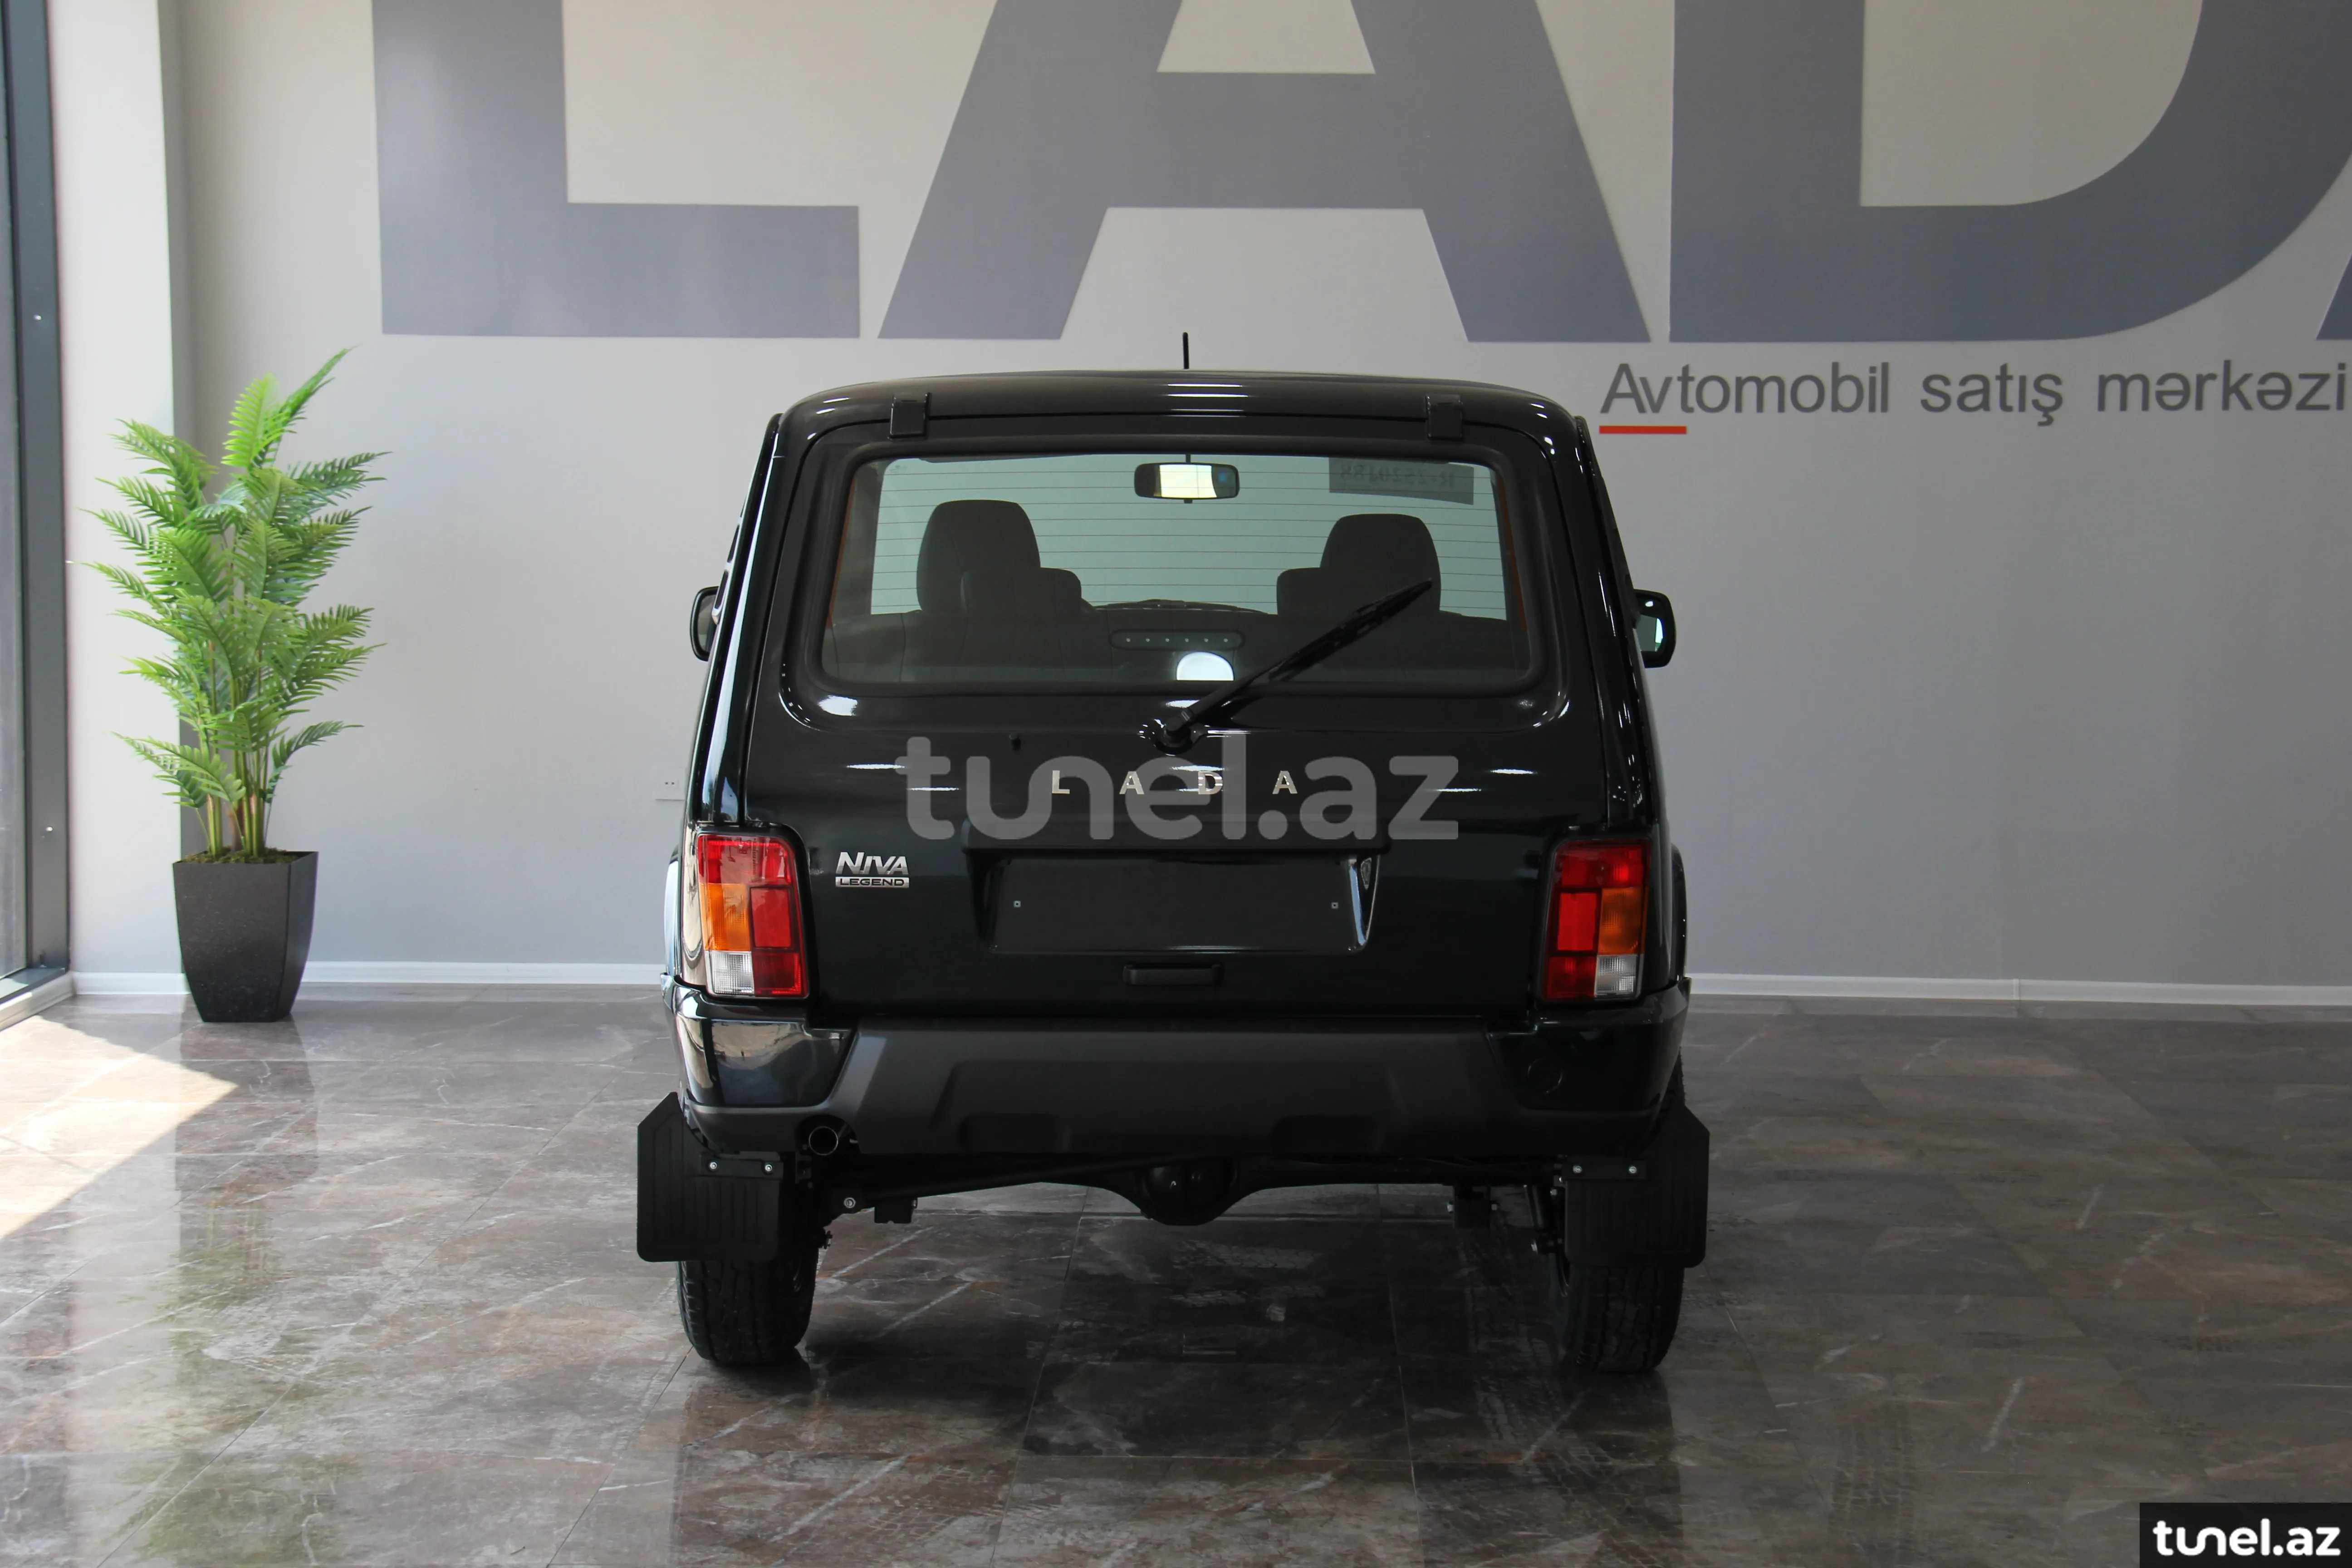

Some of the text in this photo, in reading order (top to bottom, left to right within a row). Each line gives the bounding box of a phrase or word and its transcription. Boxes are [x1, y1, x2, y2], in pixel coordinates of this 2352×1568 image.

[372, 0, 2352, 341] LAD
[1600, 359, 2349, 427] Avtomobil satış mərkəzi
[1051, 769, 1298, 795] LADA
[836, 852, 909, 875] NIVA
[840, 878, 905, 886] LEGEND
